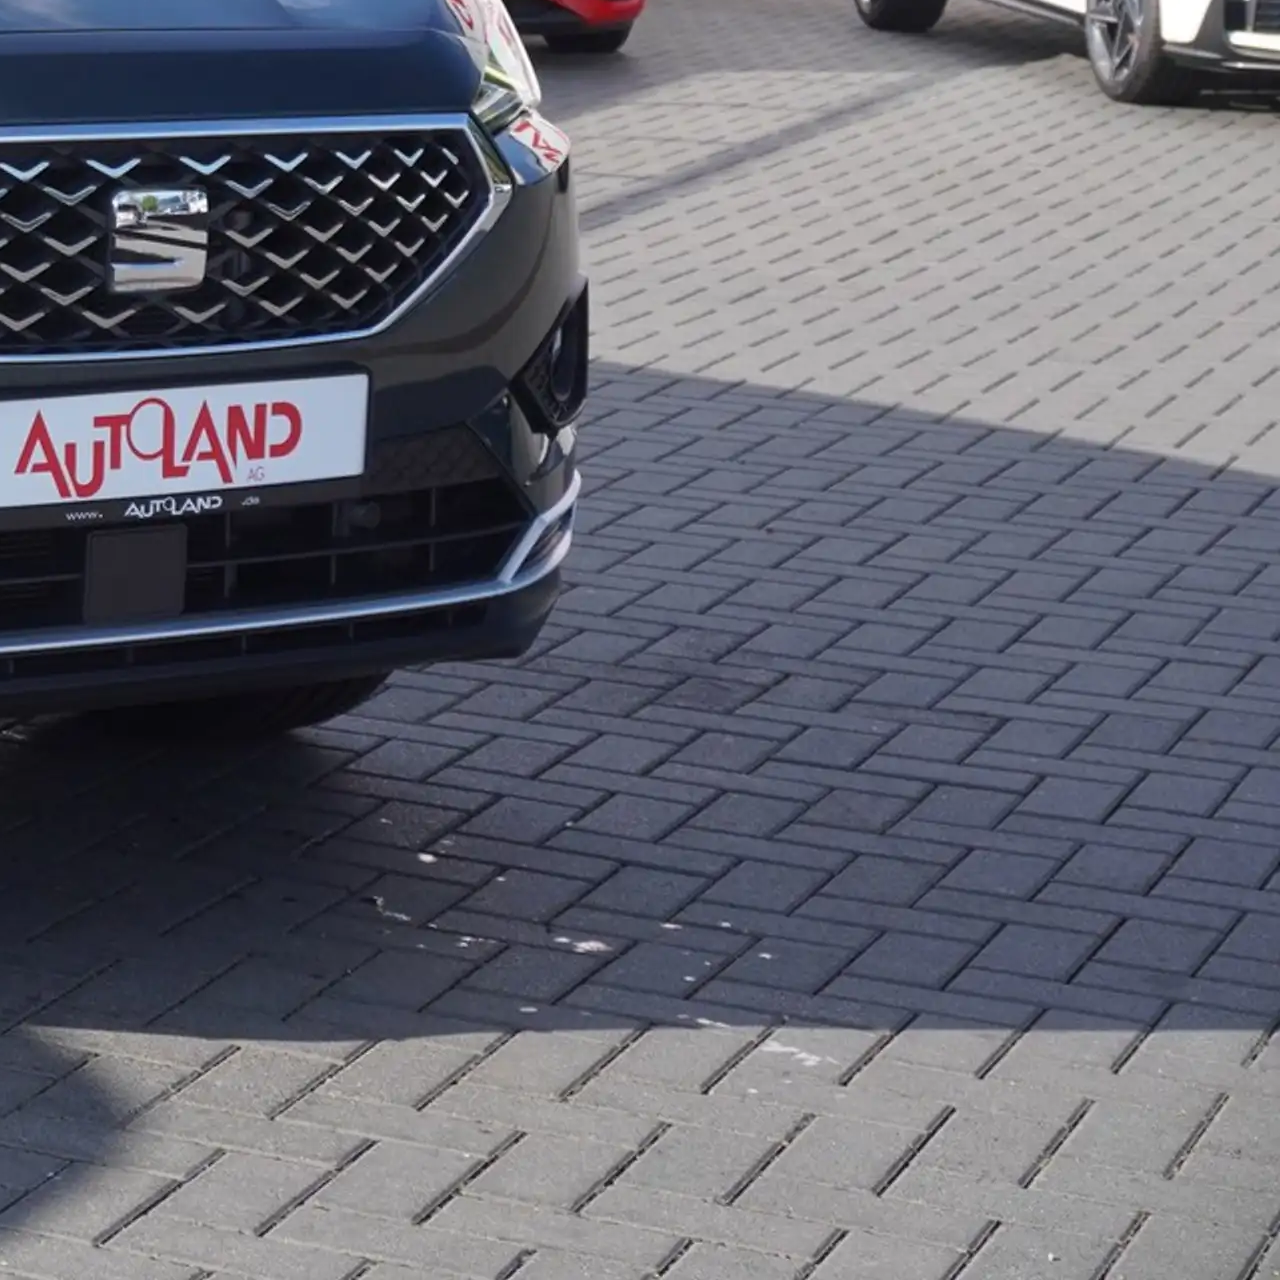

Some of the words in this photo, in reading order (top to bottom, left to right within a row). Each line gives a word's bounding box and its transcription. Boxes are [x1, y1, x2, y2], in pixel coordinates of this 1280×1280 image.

[14, 397, 303, 499] AUTOLAND
[246, 466, 265, 482] AG
[123, 496, 224, 519] AUTOLAND
